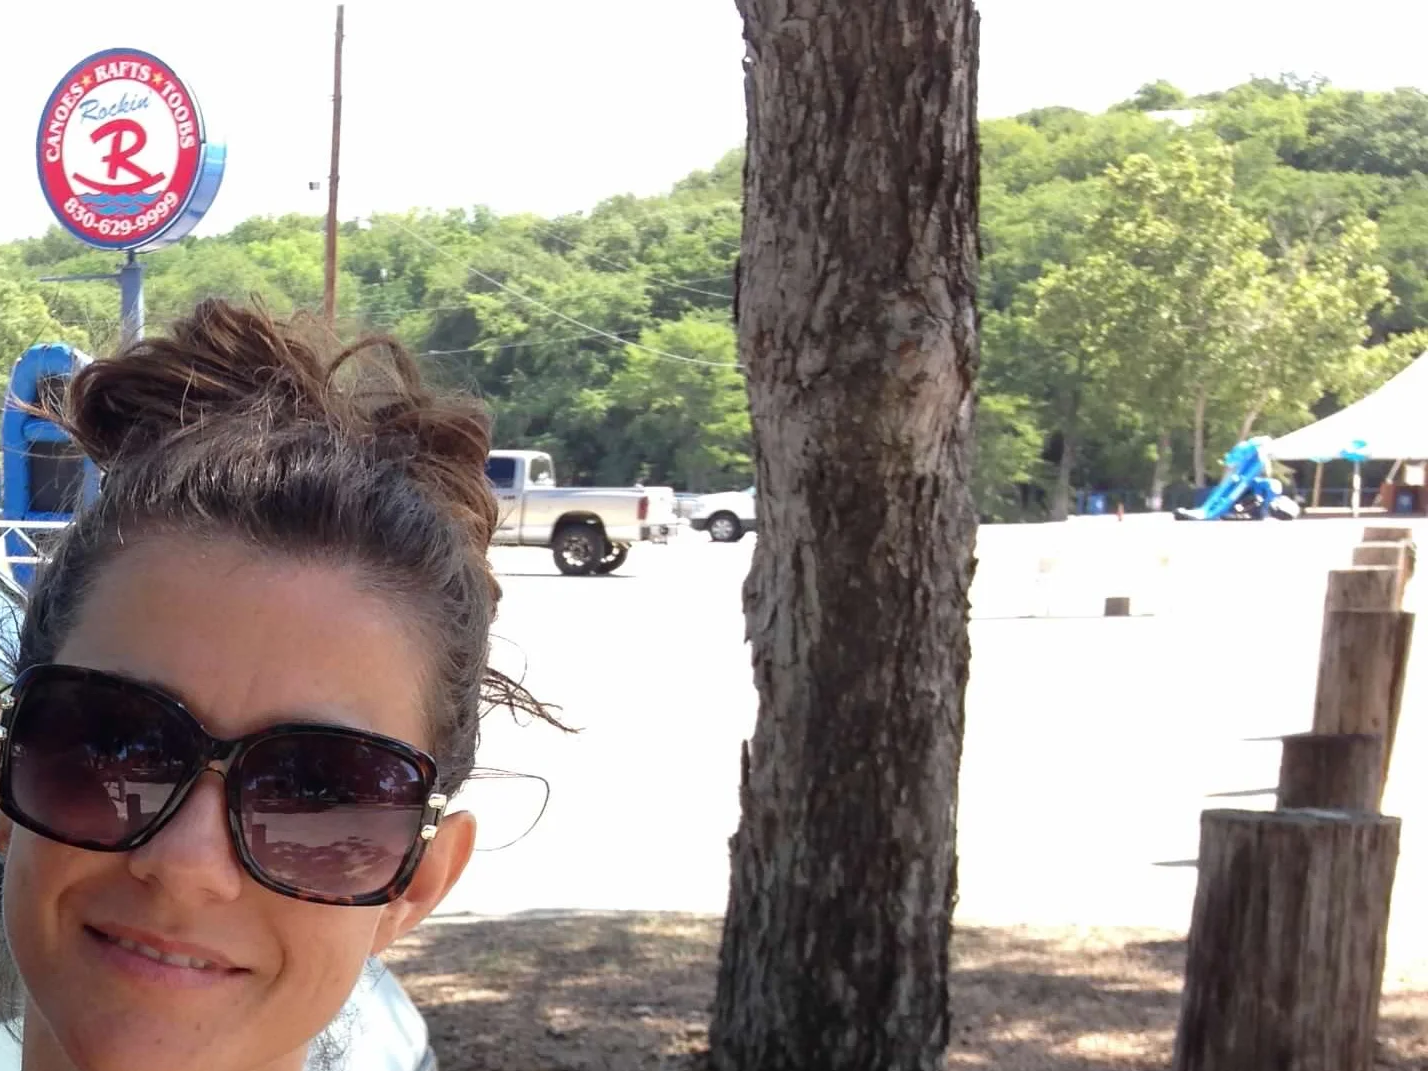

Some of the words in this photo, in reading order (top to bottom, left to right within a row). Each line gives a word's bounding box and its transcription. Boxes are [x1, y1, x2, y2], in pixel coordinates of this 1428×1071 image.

[46, 82, 84, 163] CANOES
[94, 61, 152, 84] RAFTS
[161, 80, 196, 149] TOOBS
[64, 192, 178, 236] 830-629-9999
